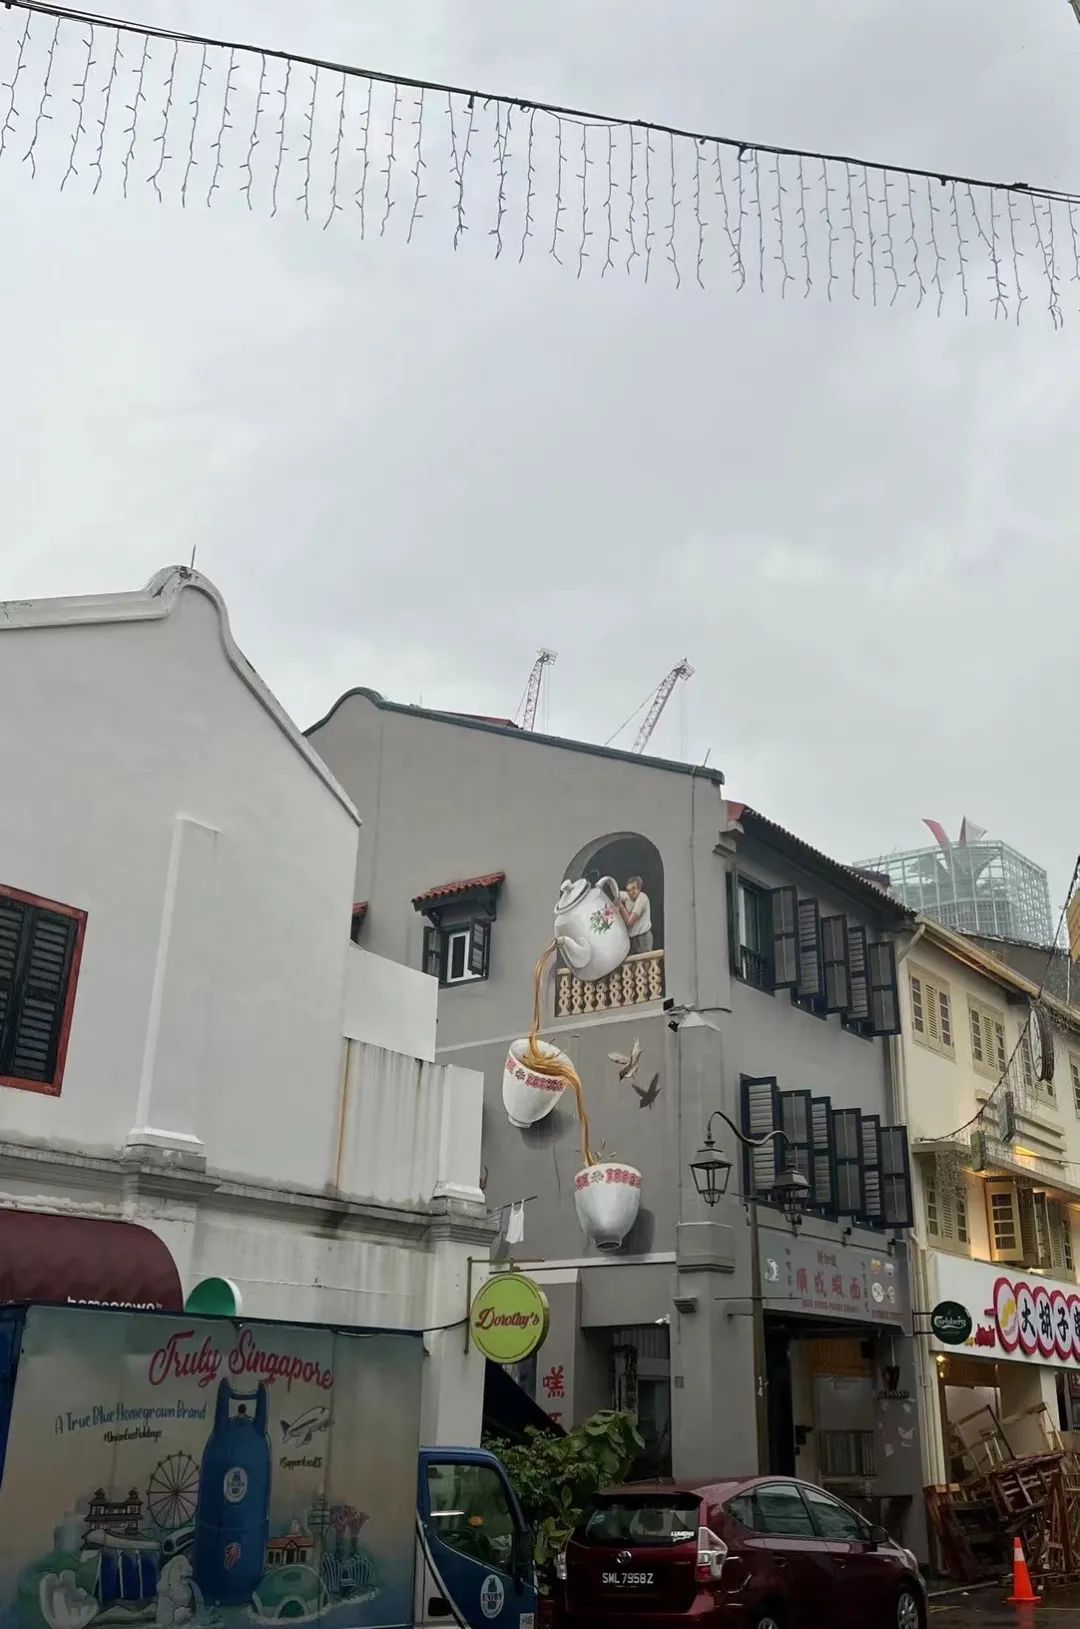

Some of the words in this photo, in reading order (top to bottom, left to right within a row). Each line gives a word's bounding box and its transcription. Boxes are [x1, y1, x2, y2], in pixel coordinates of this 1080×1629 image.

[475, 1307, 540, 1330] Dorothy's
[933, 1315, 967, 1329] Carlsberg
[149, 1330, 222, 1387] Truly
[227, 1328, 335, 1391] Singapore
[55, 1415, 64, 1434] A
[66, 1411, 91, 1431] True
[92, 1403, 115, 1425] Blue
[115, 1402, 176, 1426] Homegrown
[176, 1399, 207, 1419] Brand
